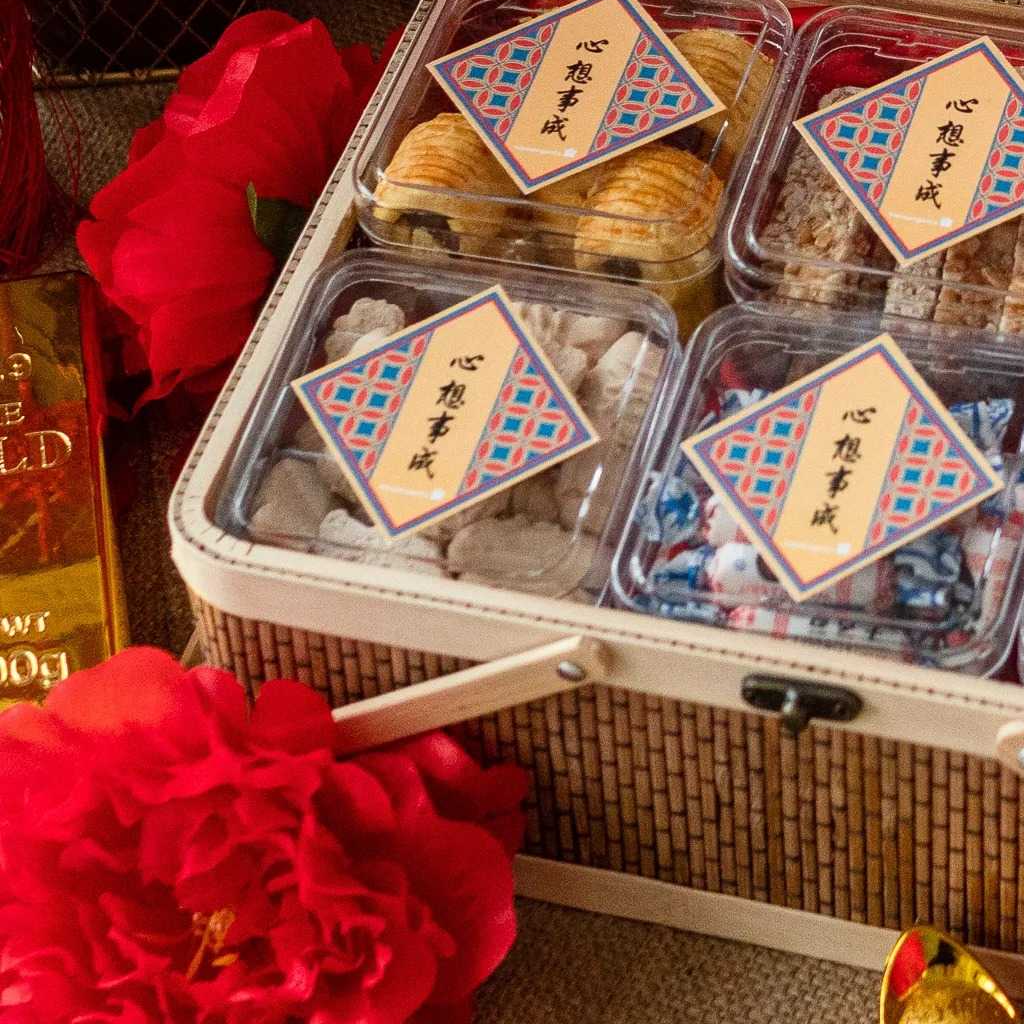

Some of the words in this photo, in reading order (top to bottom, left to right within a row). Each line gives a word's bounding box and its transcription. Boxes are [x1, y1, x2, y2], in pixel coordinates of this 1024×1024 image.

[540, 38, 609, 142] 心想事成
[915, 97, 978, 210] 心想事成
[408, 354, 485, 479] 心想事成
[810, 407, 876, 535] 心想事成
